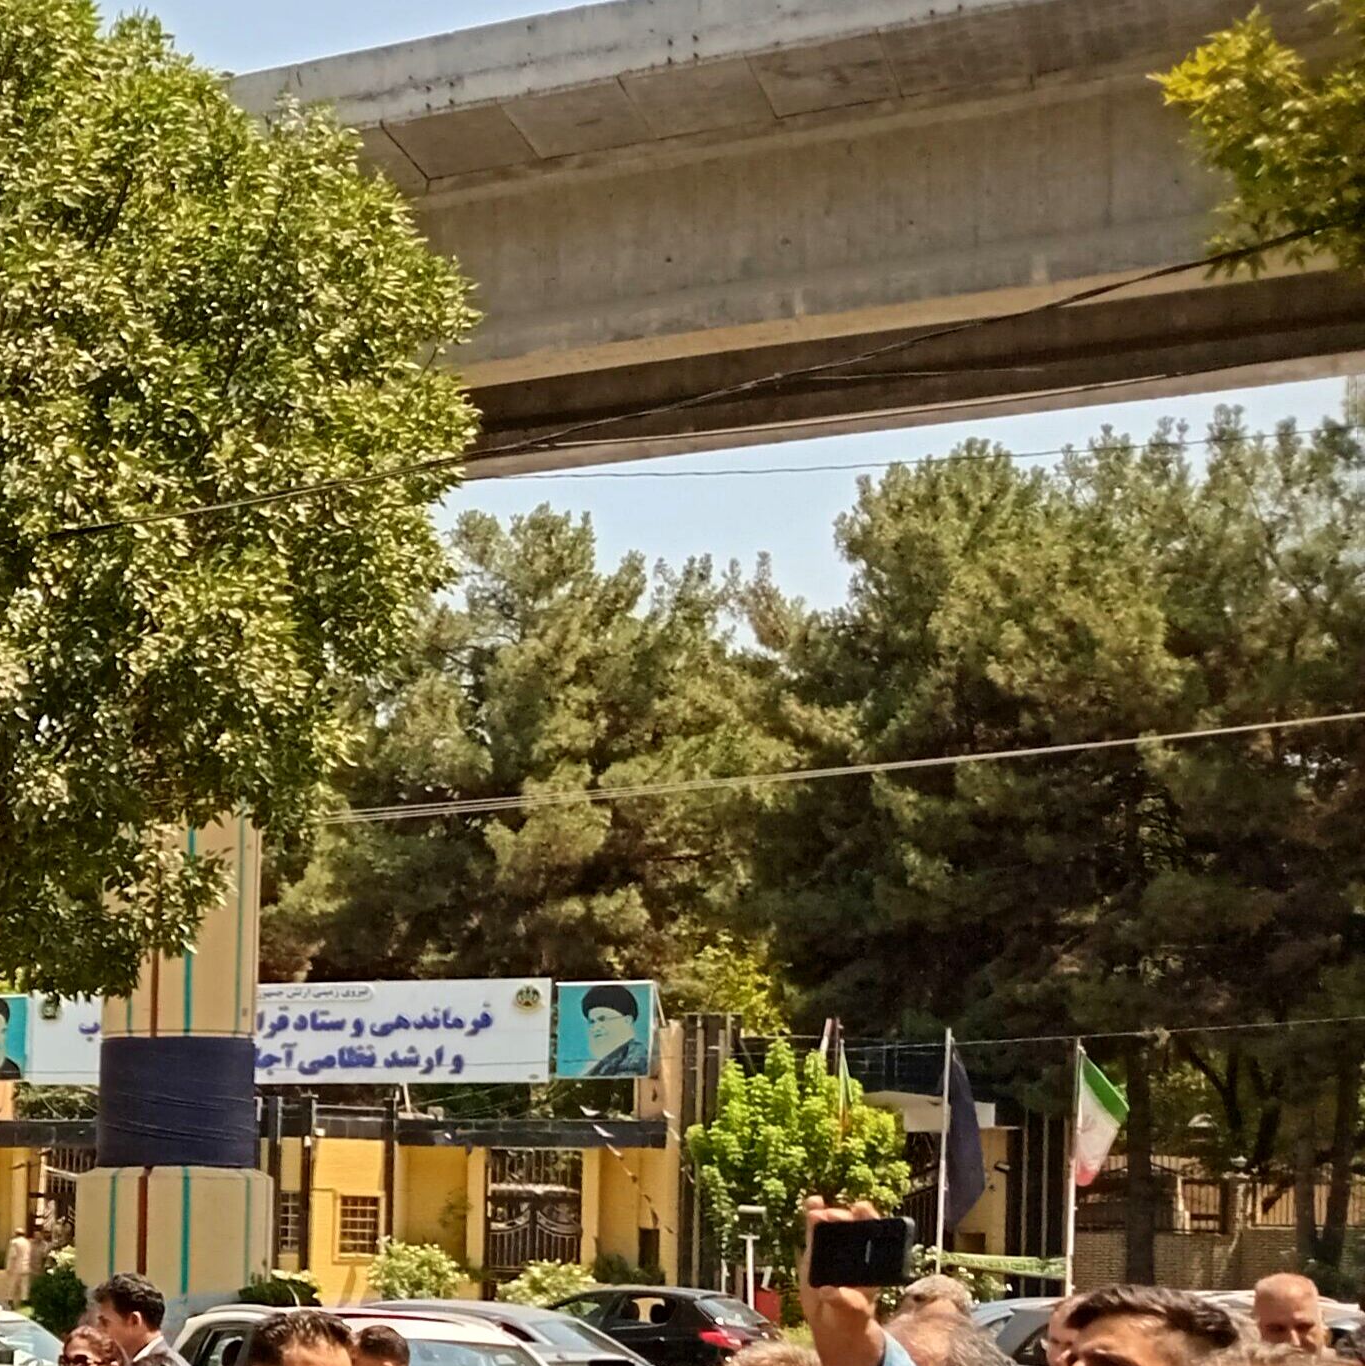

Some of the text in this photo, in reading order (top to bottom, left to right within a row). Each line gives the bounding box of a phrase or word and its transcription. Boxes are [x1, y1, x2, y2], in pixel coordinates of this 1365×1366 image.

[256, 1001, 493, 1039] فرماندهی و ستاد قرا
[298, 1044, 377, 1076] نظامی
[384, 1045, 444, 1075] ارشد
